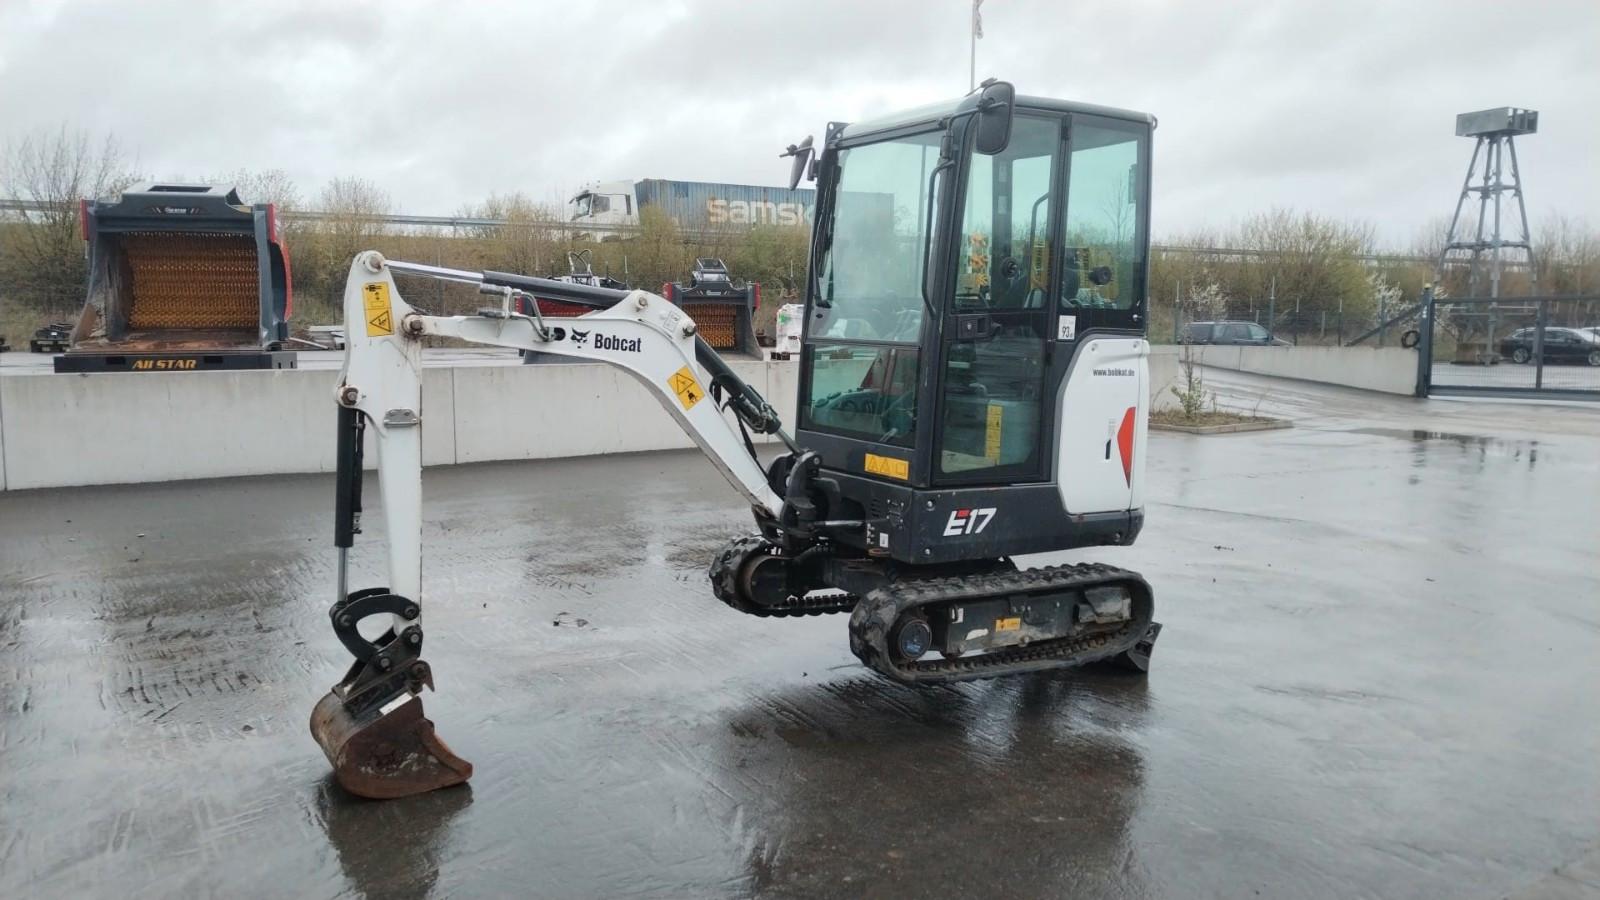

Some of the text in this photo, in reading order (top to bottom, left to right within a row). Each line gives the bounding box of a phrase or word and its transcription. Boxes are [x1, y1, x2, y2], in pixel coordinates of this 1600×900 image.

[593, 333, 642, 352] Bobcat
[156, 359, 197, 370] STAR
[943, 507, 997, 537] E17
